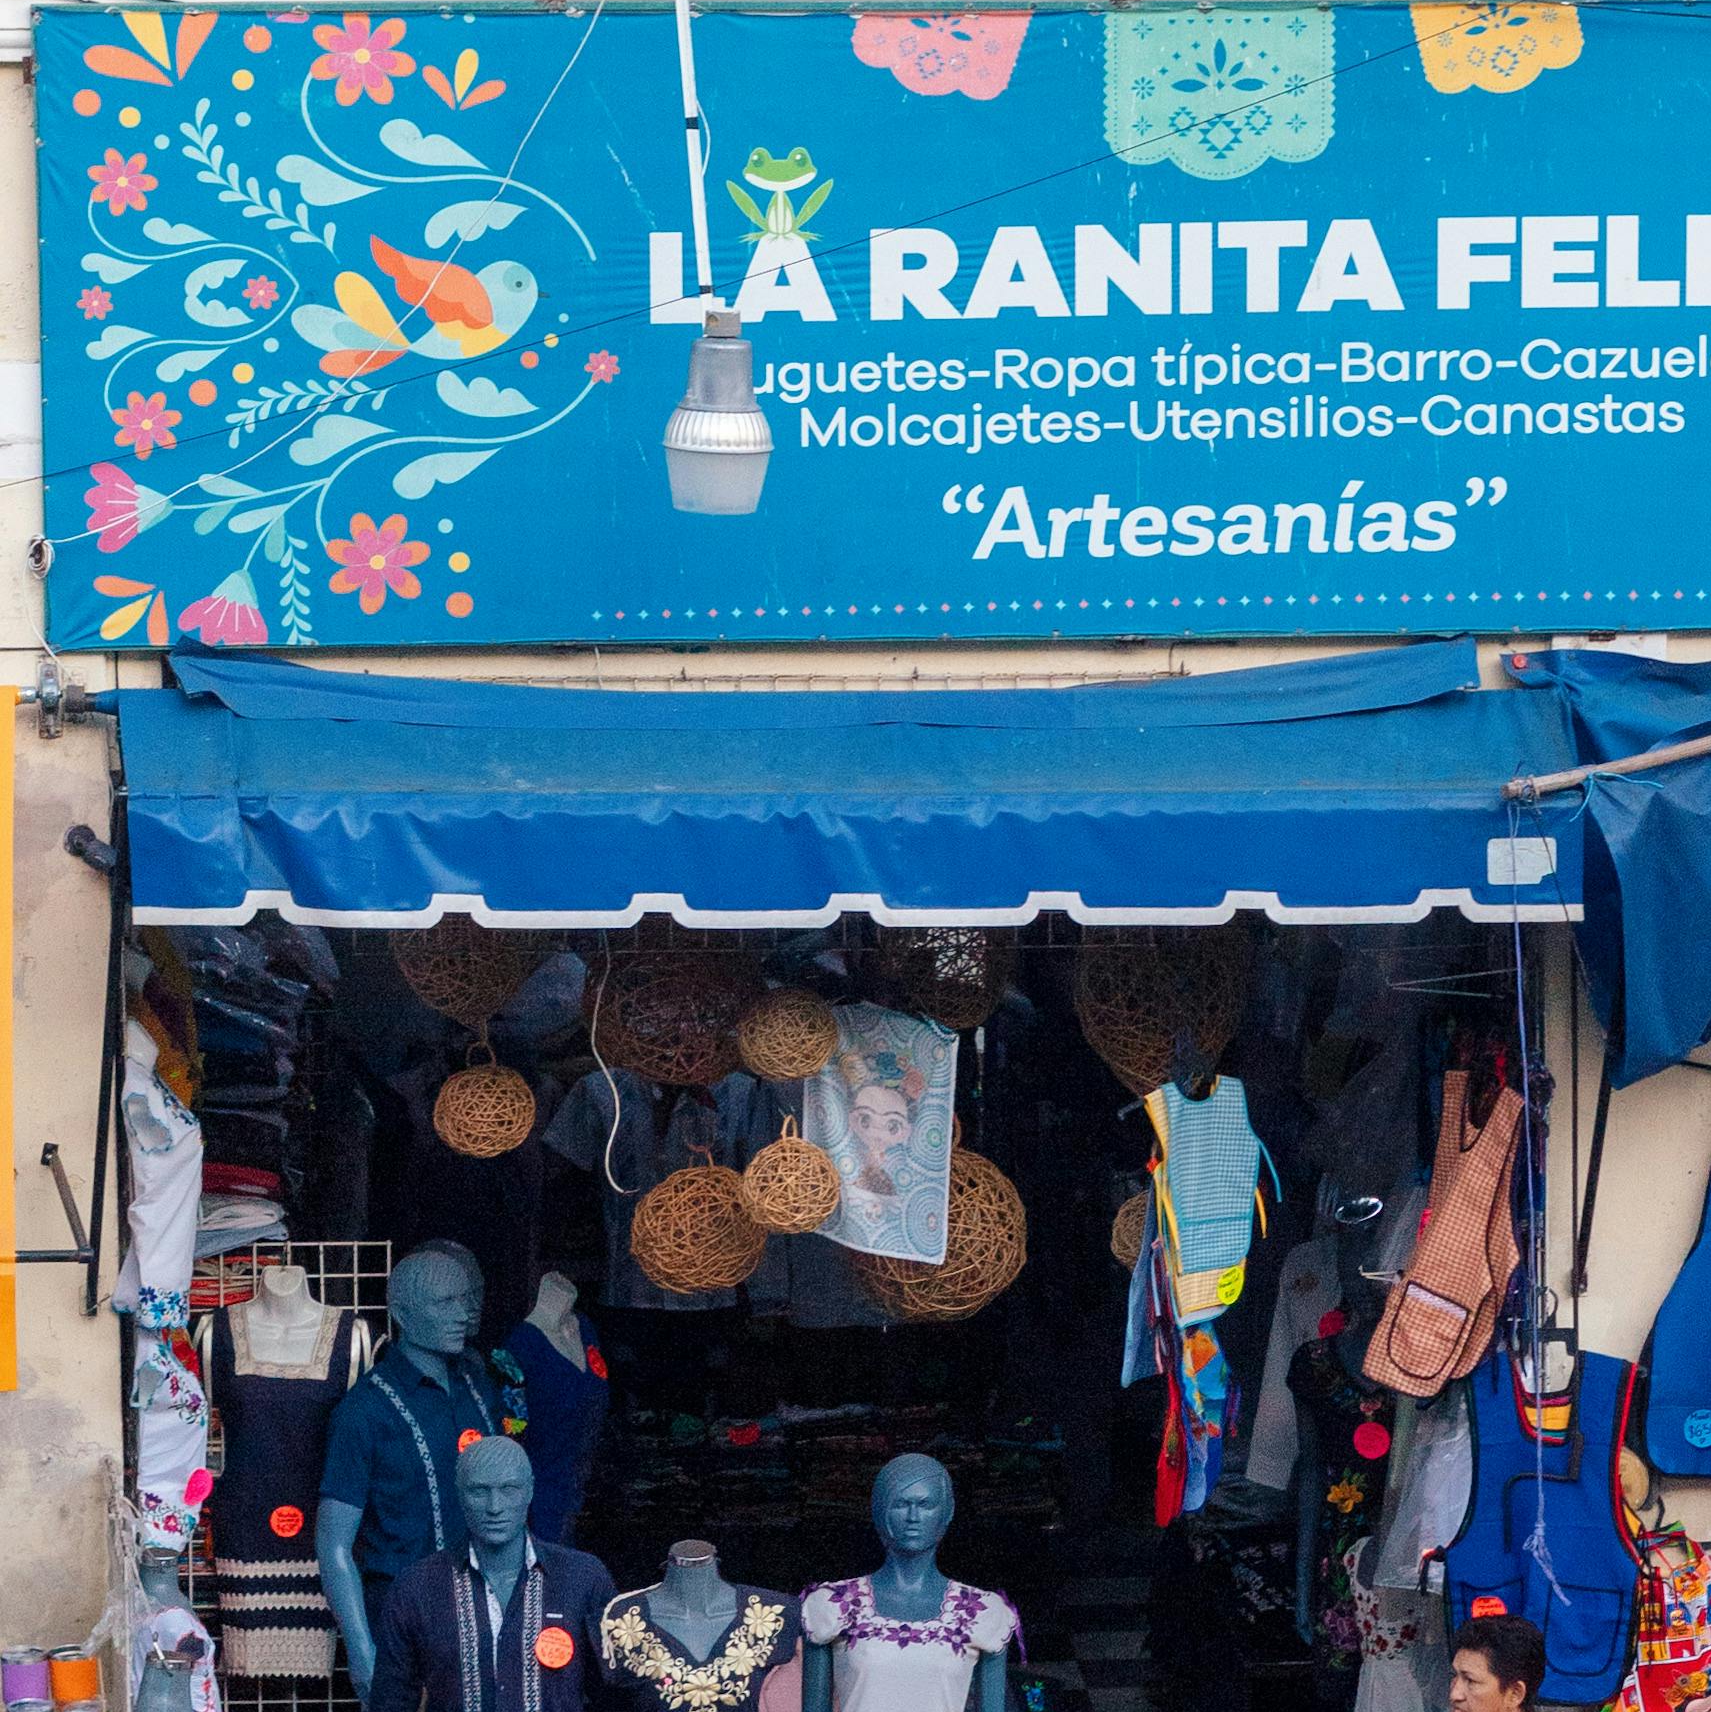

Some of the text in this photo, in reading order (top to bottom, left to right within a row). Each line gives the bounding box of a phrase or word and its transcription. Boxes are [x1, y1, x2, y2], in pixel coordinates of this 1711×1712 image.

[650, 231, 837, 326] LA
[870, 220, 1405, 321] RANITA
[752, 349, 1135, 404] uguetes-Ropa
[800, 394, 1685, 454] Molcajetes-Utensilios-Canastas
